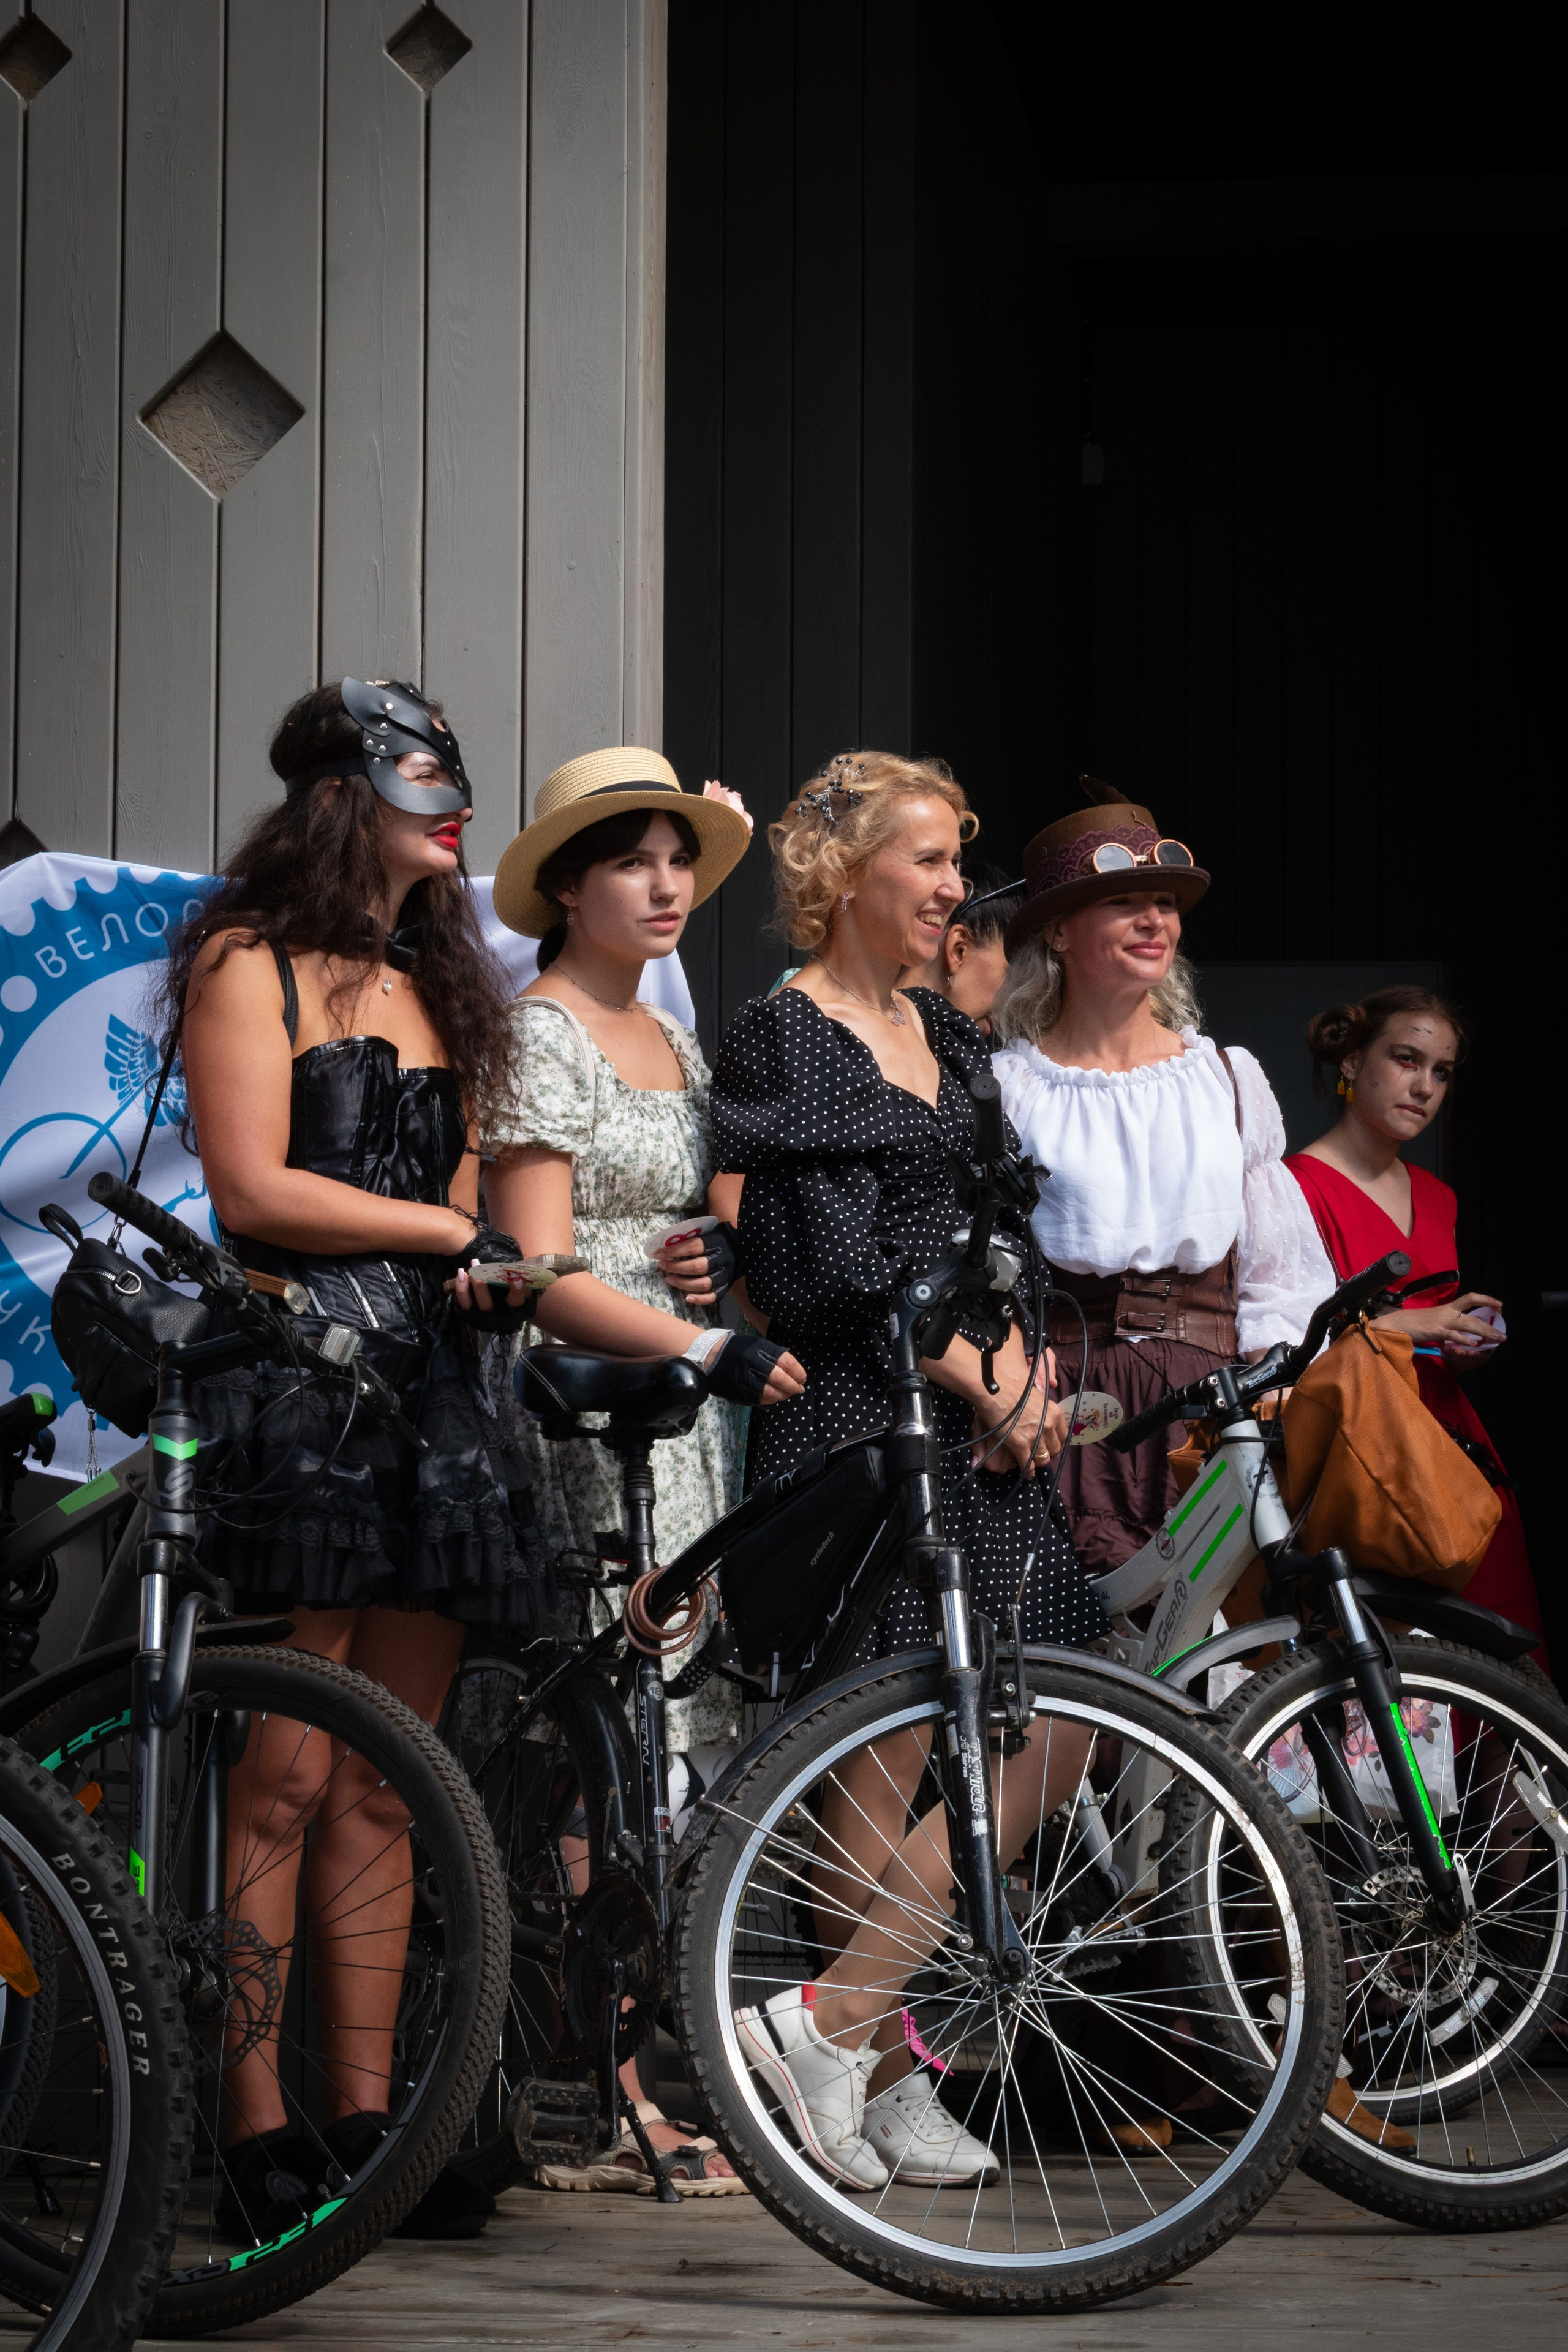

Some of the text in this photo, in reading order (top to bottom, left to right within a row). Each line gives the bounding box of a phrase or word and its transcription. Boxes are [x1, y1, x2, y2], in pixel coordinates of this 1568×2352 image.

[810, 1531, 834, 1566] cyclotech
[639, 1694, 650, 1765] STERN
[51, 1853, 150, 2076] BONTRAGER
